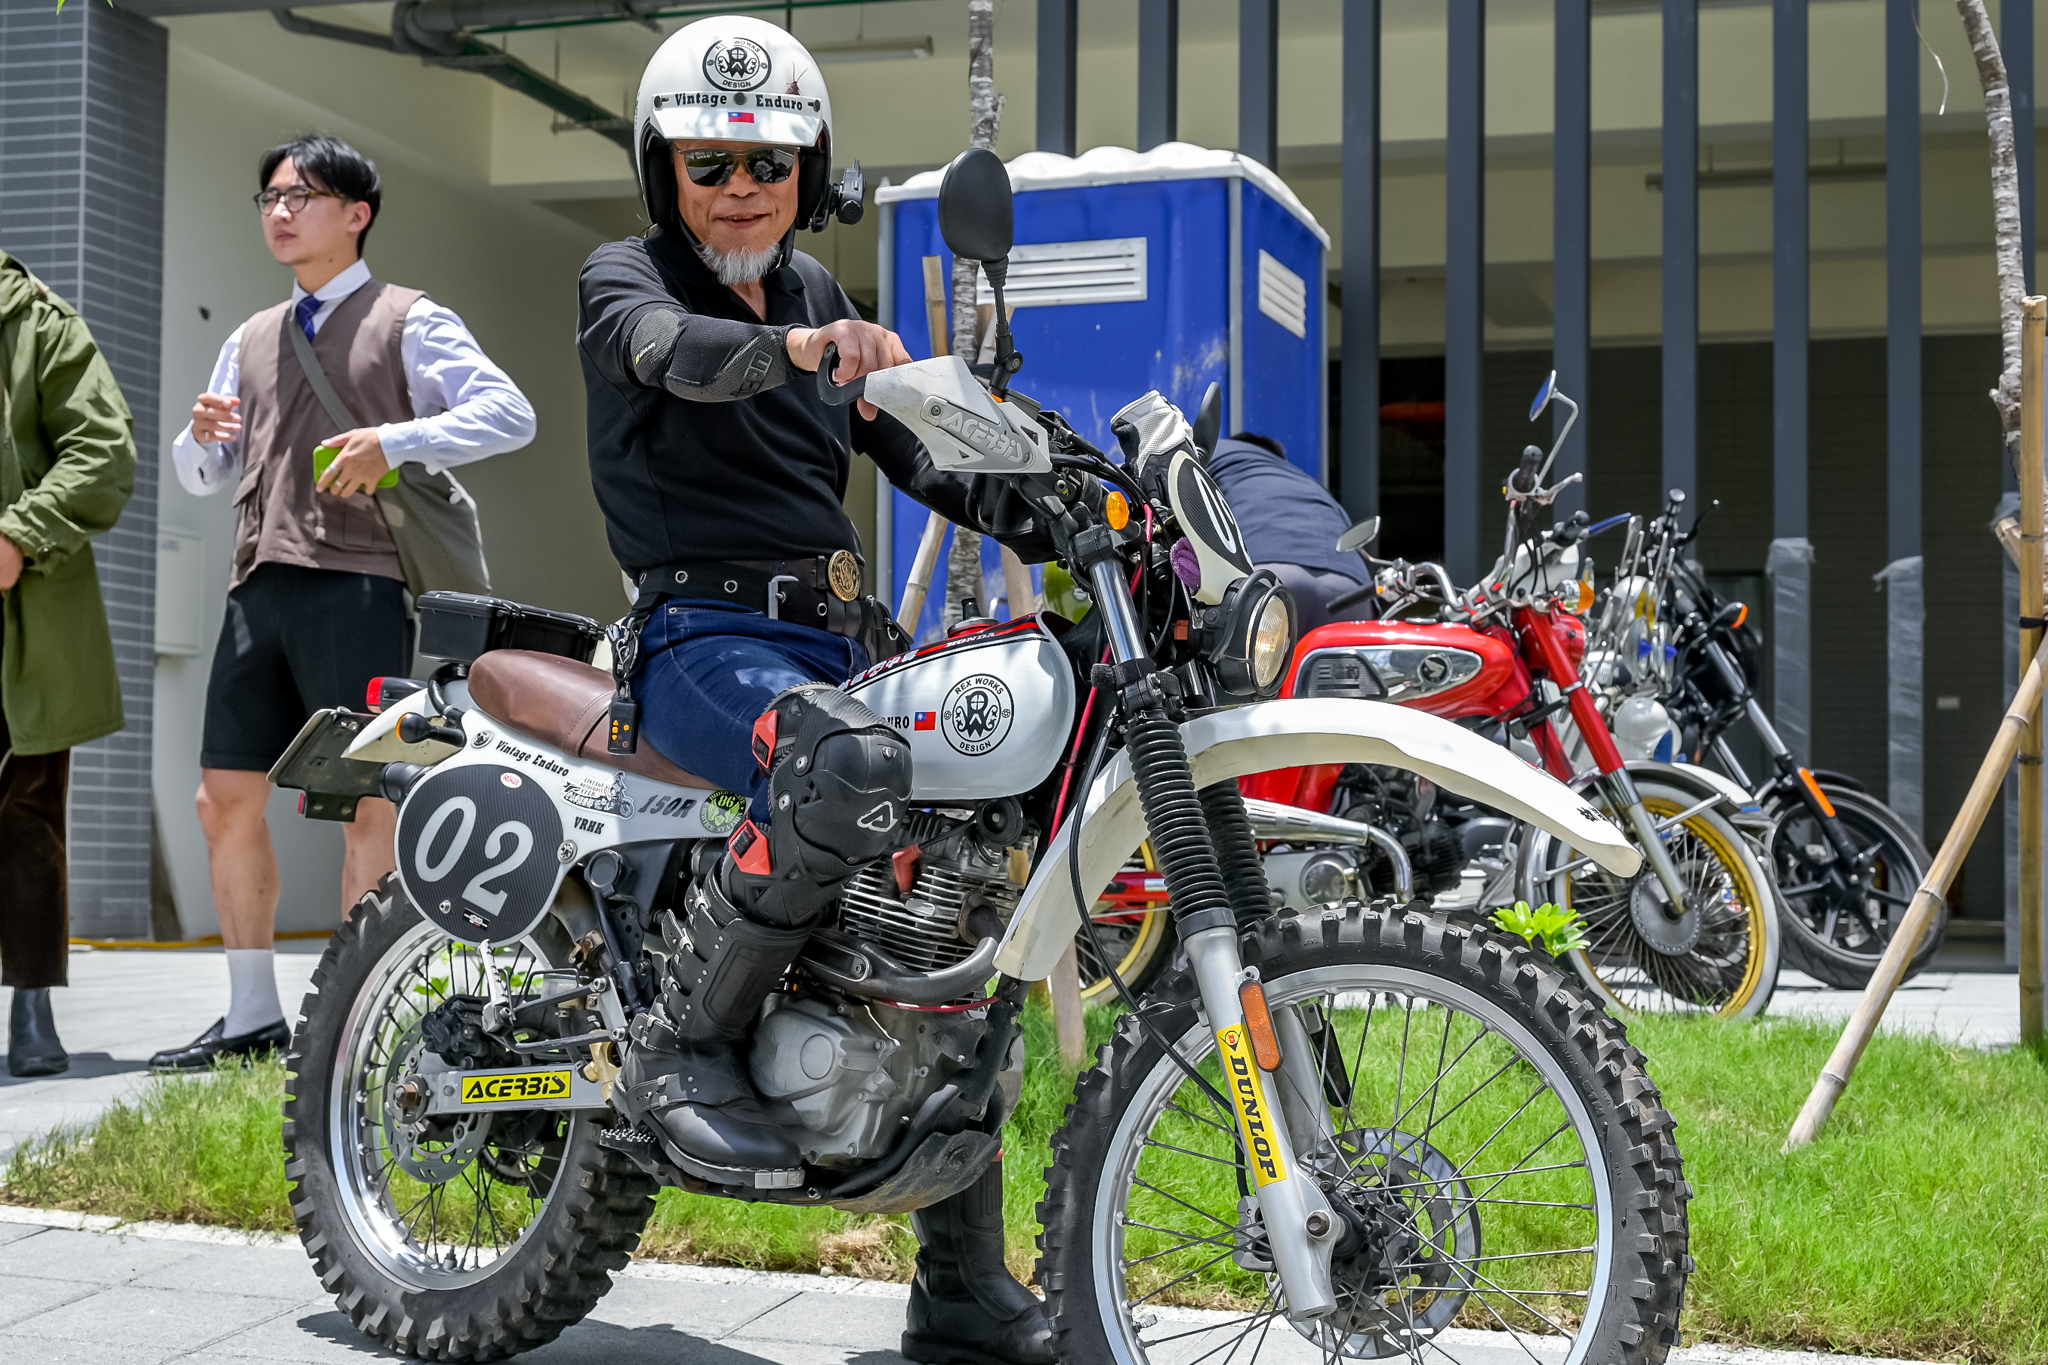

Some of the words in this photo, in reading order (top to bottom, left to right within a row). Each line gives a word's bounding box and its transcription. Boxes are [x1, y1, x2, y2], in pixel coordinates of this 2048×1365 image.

[722, 80, 751, 88] DESIGN
[675, 93, 727, 107] Vintage
[756, 94, 803, 110] Enduro
[946, 632, 996, 647] HONDA
[954, 679, 972, 695] REX
[975, 677, 1004, 695] WORKS
[959, 740, 991, 752] DESIGN
[496, 740, 531, 762] Vintage
[532, 755, 569, 776] Enduro
[638, 795, 697, 818] 150R
[717, 795, 736, 808] 86
[574, 816, 605, 834] VRHK
[415, 796, 534, 917] 02
[1230, 1055, 1278, 1179] DUNLOP
